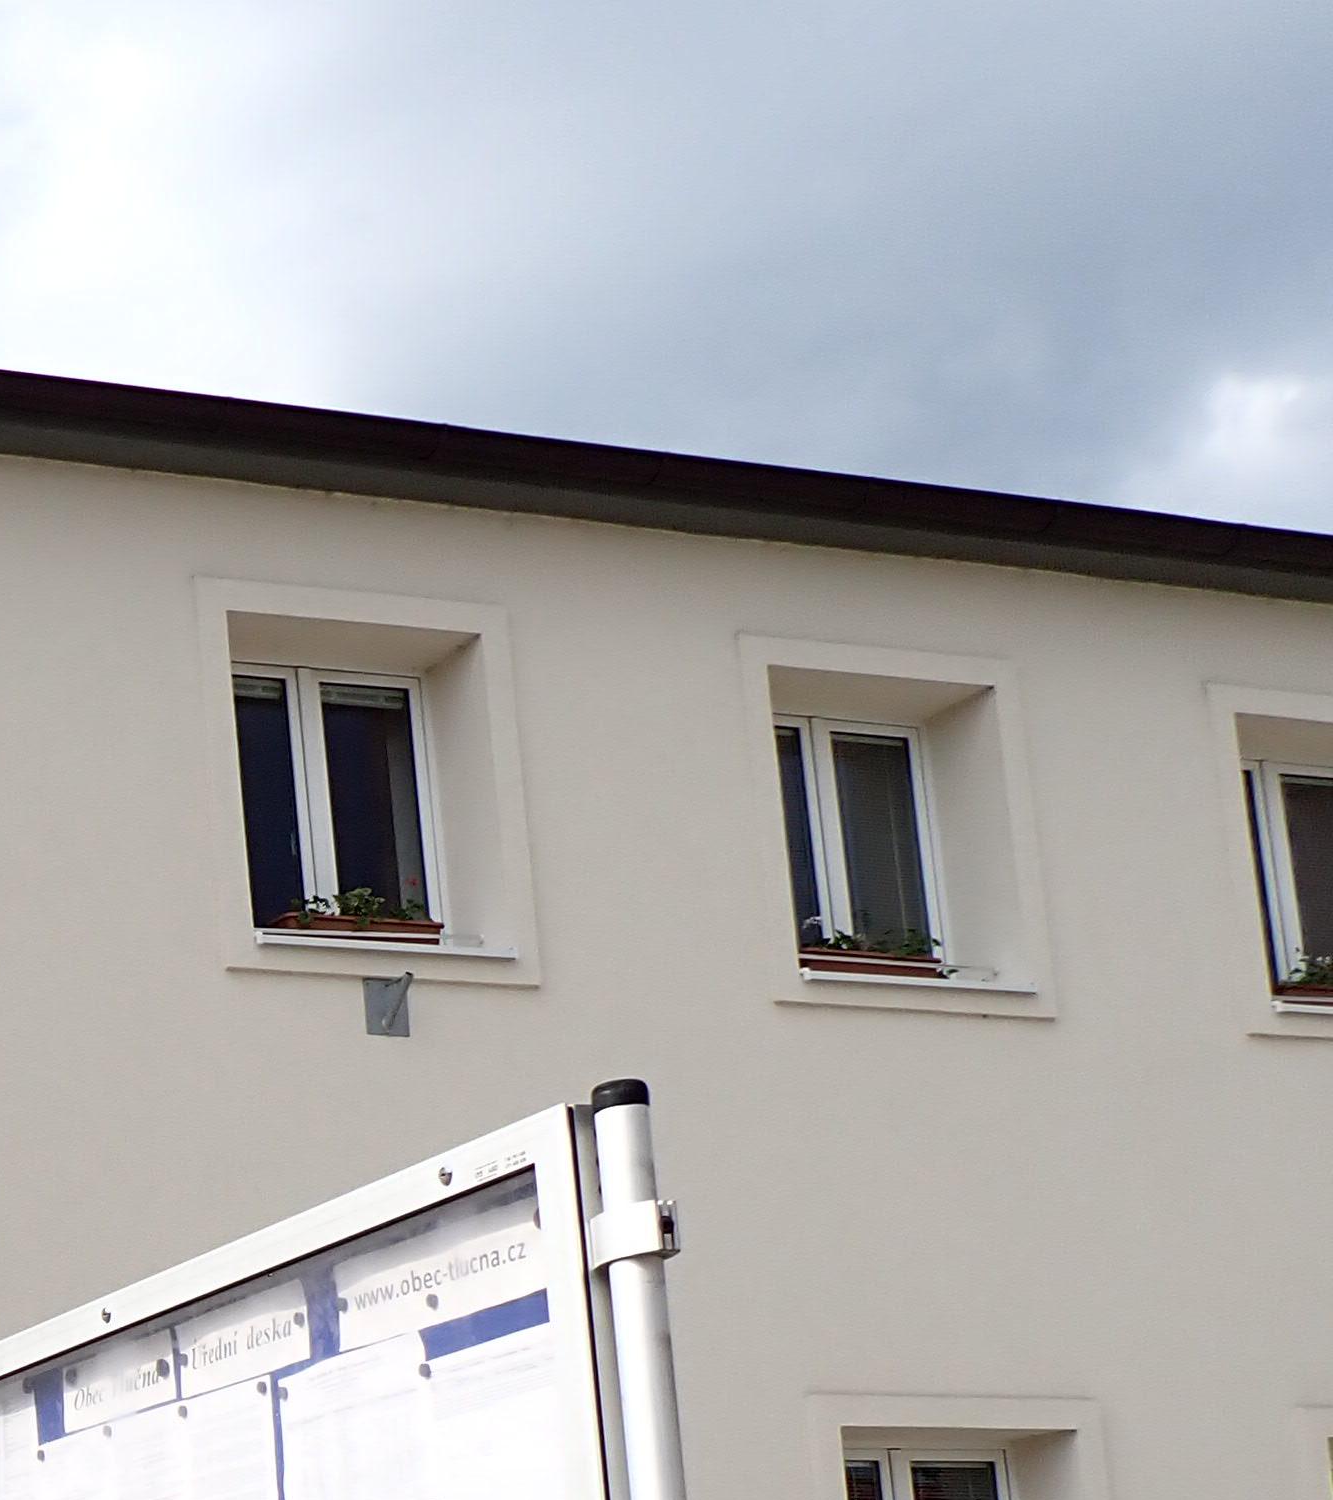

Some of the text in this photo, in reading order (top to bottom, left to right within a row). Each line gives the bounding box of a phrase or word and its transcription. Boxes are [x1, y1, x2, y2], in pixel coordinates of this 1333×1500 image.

[354, 1242, 527, 1311] www.obec-tlucna.cz
[191, 1318, 292, 1370] Úřední deska
[74, 1386, 104, 1410] Obec
